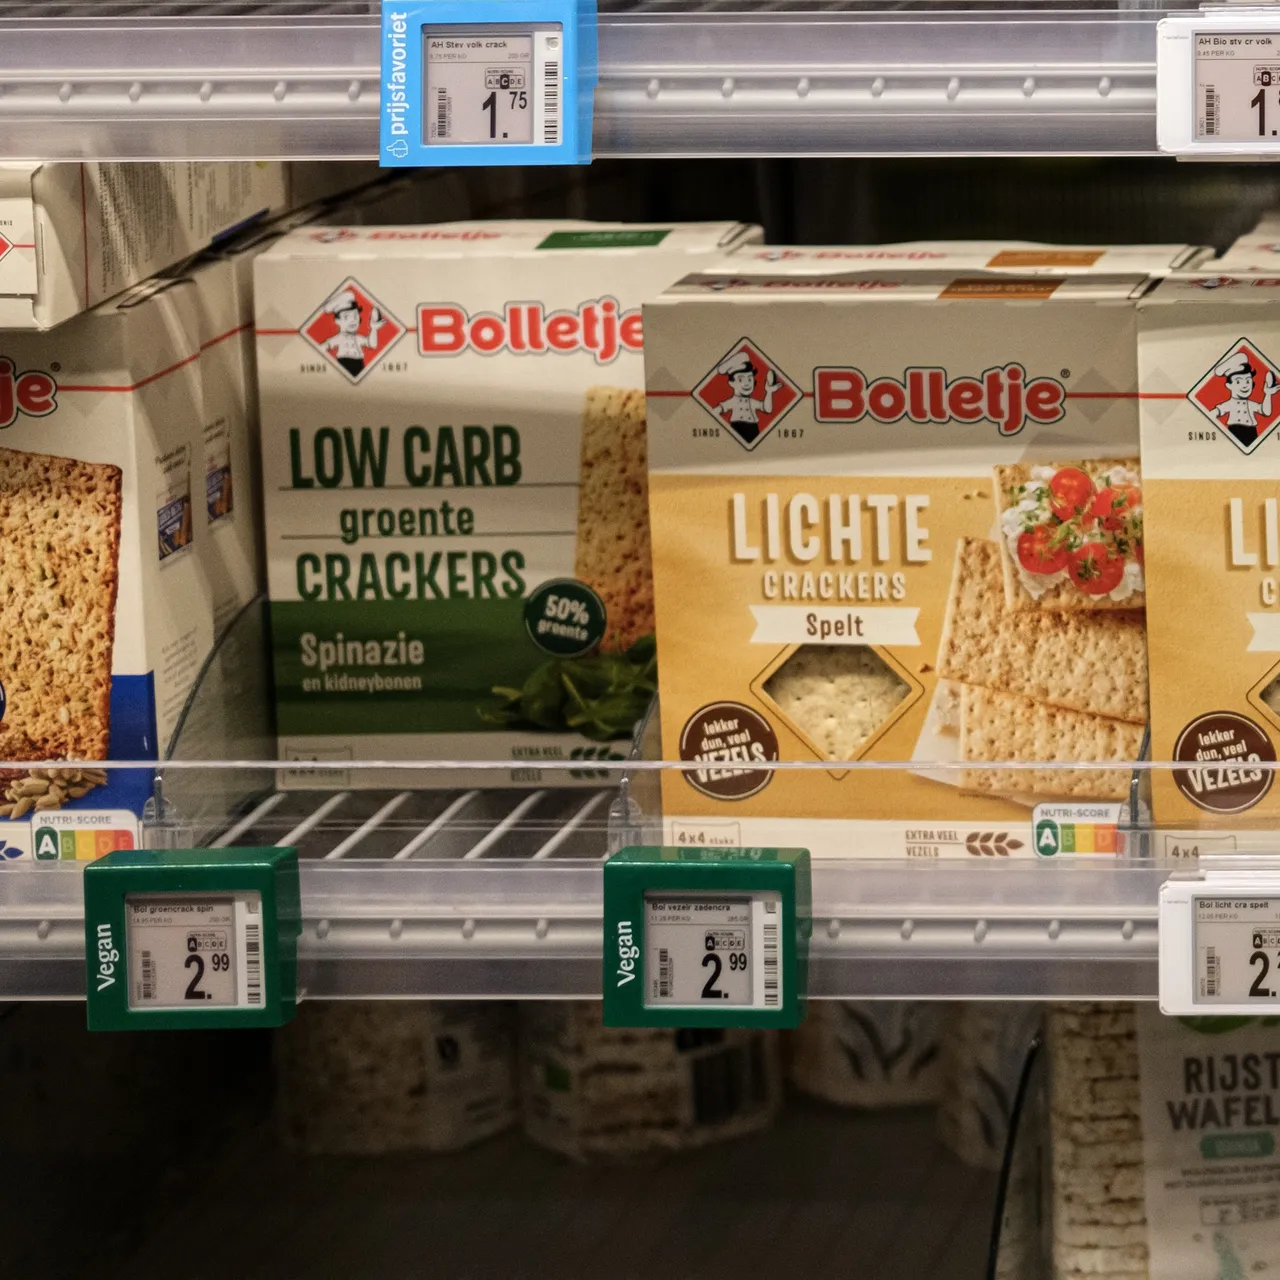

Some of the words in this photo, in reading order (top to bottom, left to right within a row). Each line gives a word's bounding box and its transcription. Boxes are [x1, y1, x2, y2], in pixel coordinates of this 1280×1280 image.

[386, 12, 409, 135] prijsfavoriet
[416, 298, 643, 363] Bolletje
[812, 362, 1066, 436] Bolletje
[1188, 431, 1217, 441] SINDS
[288, 426, 390, 489] LOW
[404, 424, 522, 487] CARB
[339, 500, 475, 544] groente
[296, 550, 527, 602] CRACKERS
[545, 595, 589, 624] 50%
[300, 632, 424, 667] Spinazie
[302, 677, 321, 691] en
[325, 673, 422, 693] kidneybonen
[1041, 808, 1110, 819] NUTRI-SCORE
[729, 953, 747, 971] 99
